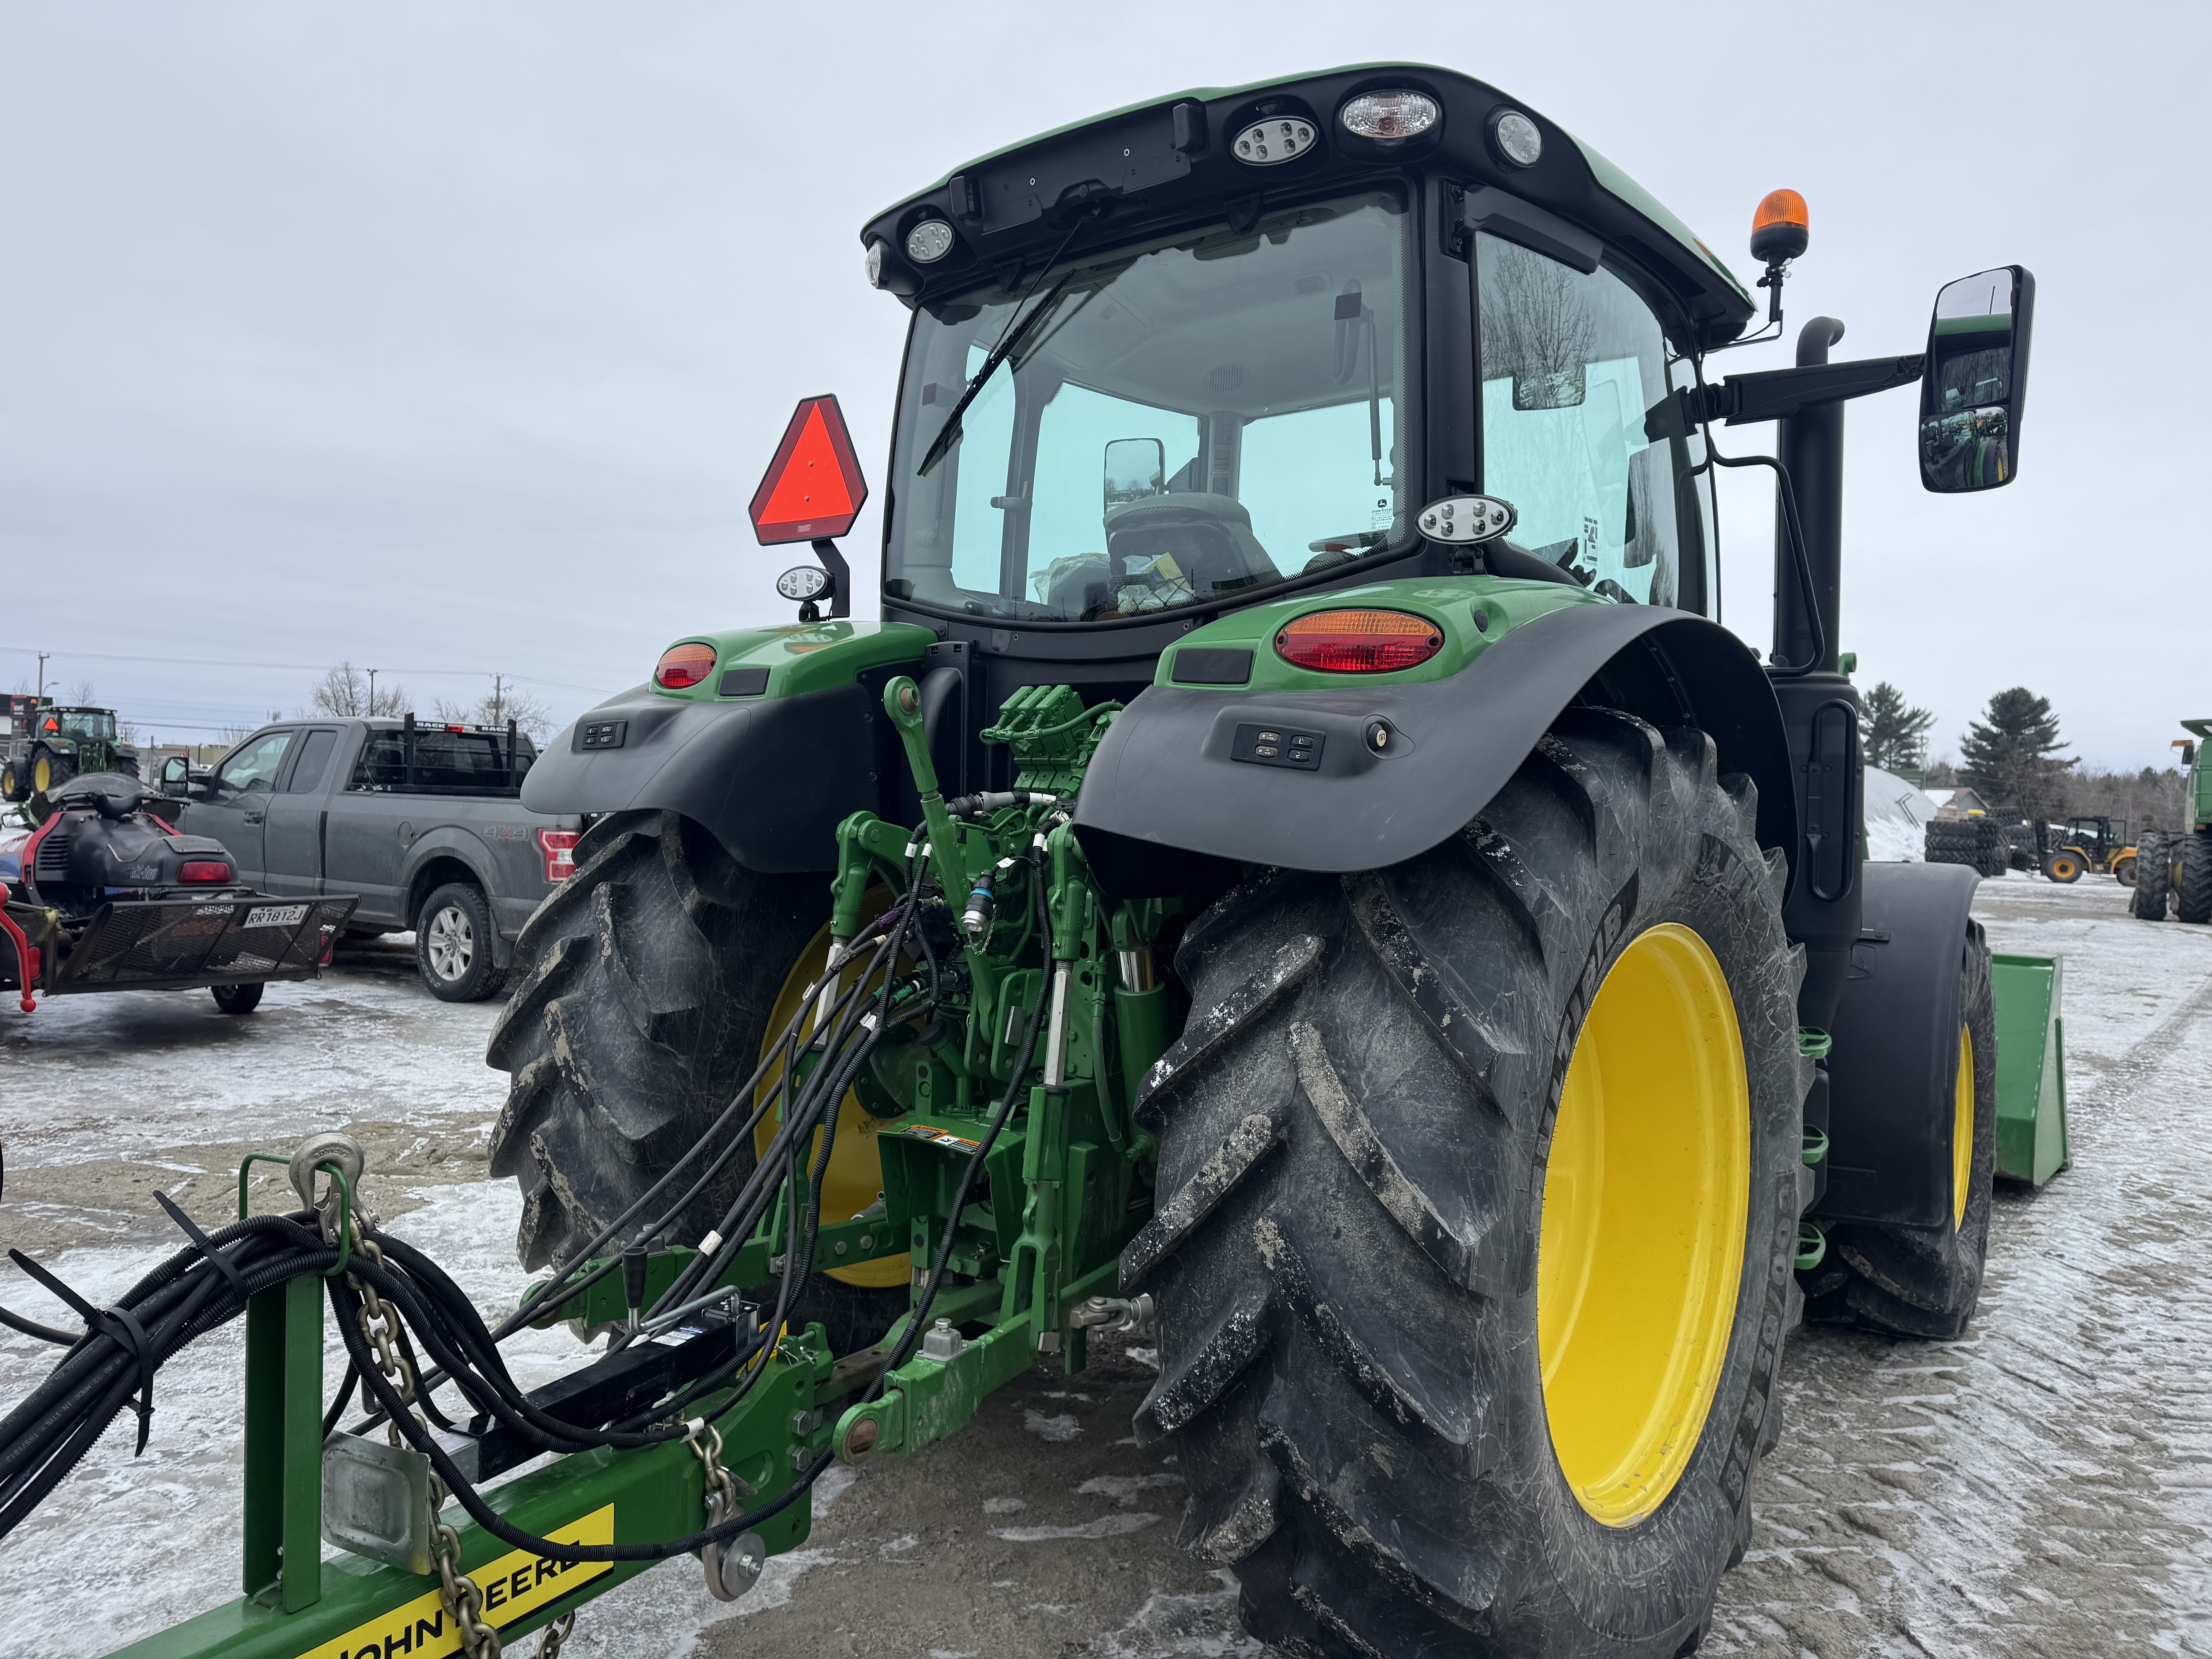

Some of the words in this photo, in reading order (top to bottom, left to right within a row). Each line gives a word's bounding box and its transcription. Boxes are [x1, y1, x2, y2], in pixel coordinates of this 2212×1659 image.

[73, 1383, 93, 1401] MADE
[61, 1401, 72, 1411] IN
[38, 1411, 62, 1431] ITALY
[340, 1609, 443, 1659] OHN
